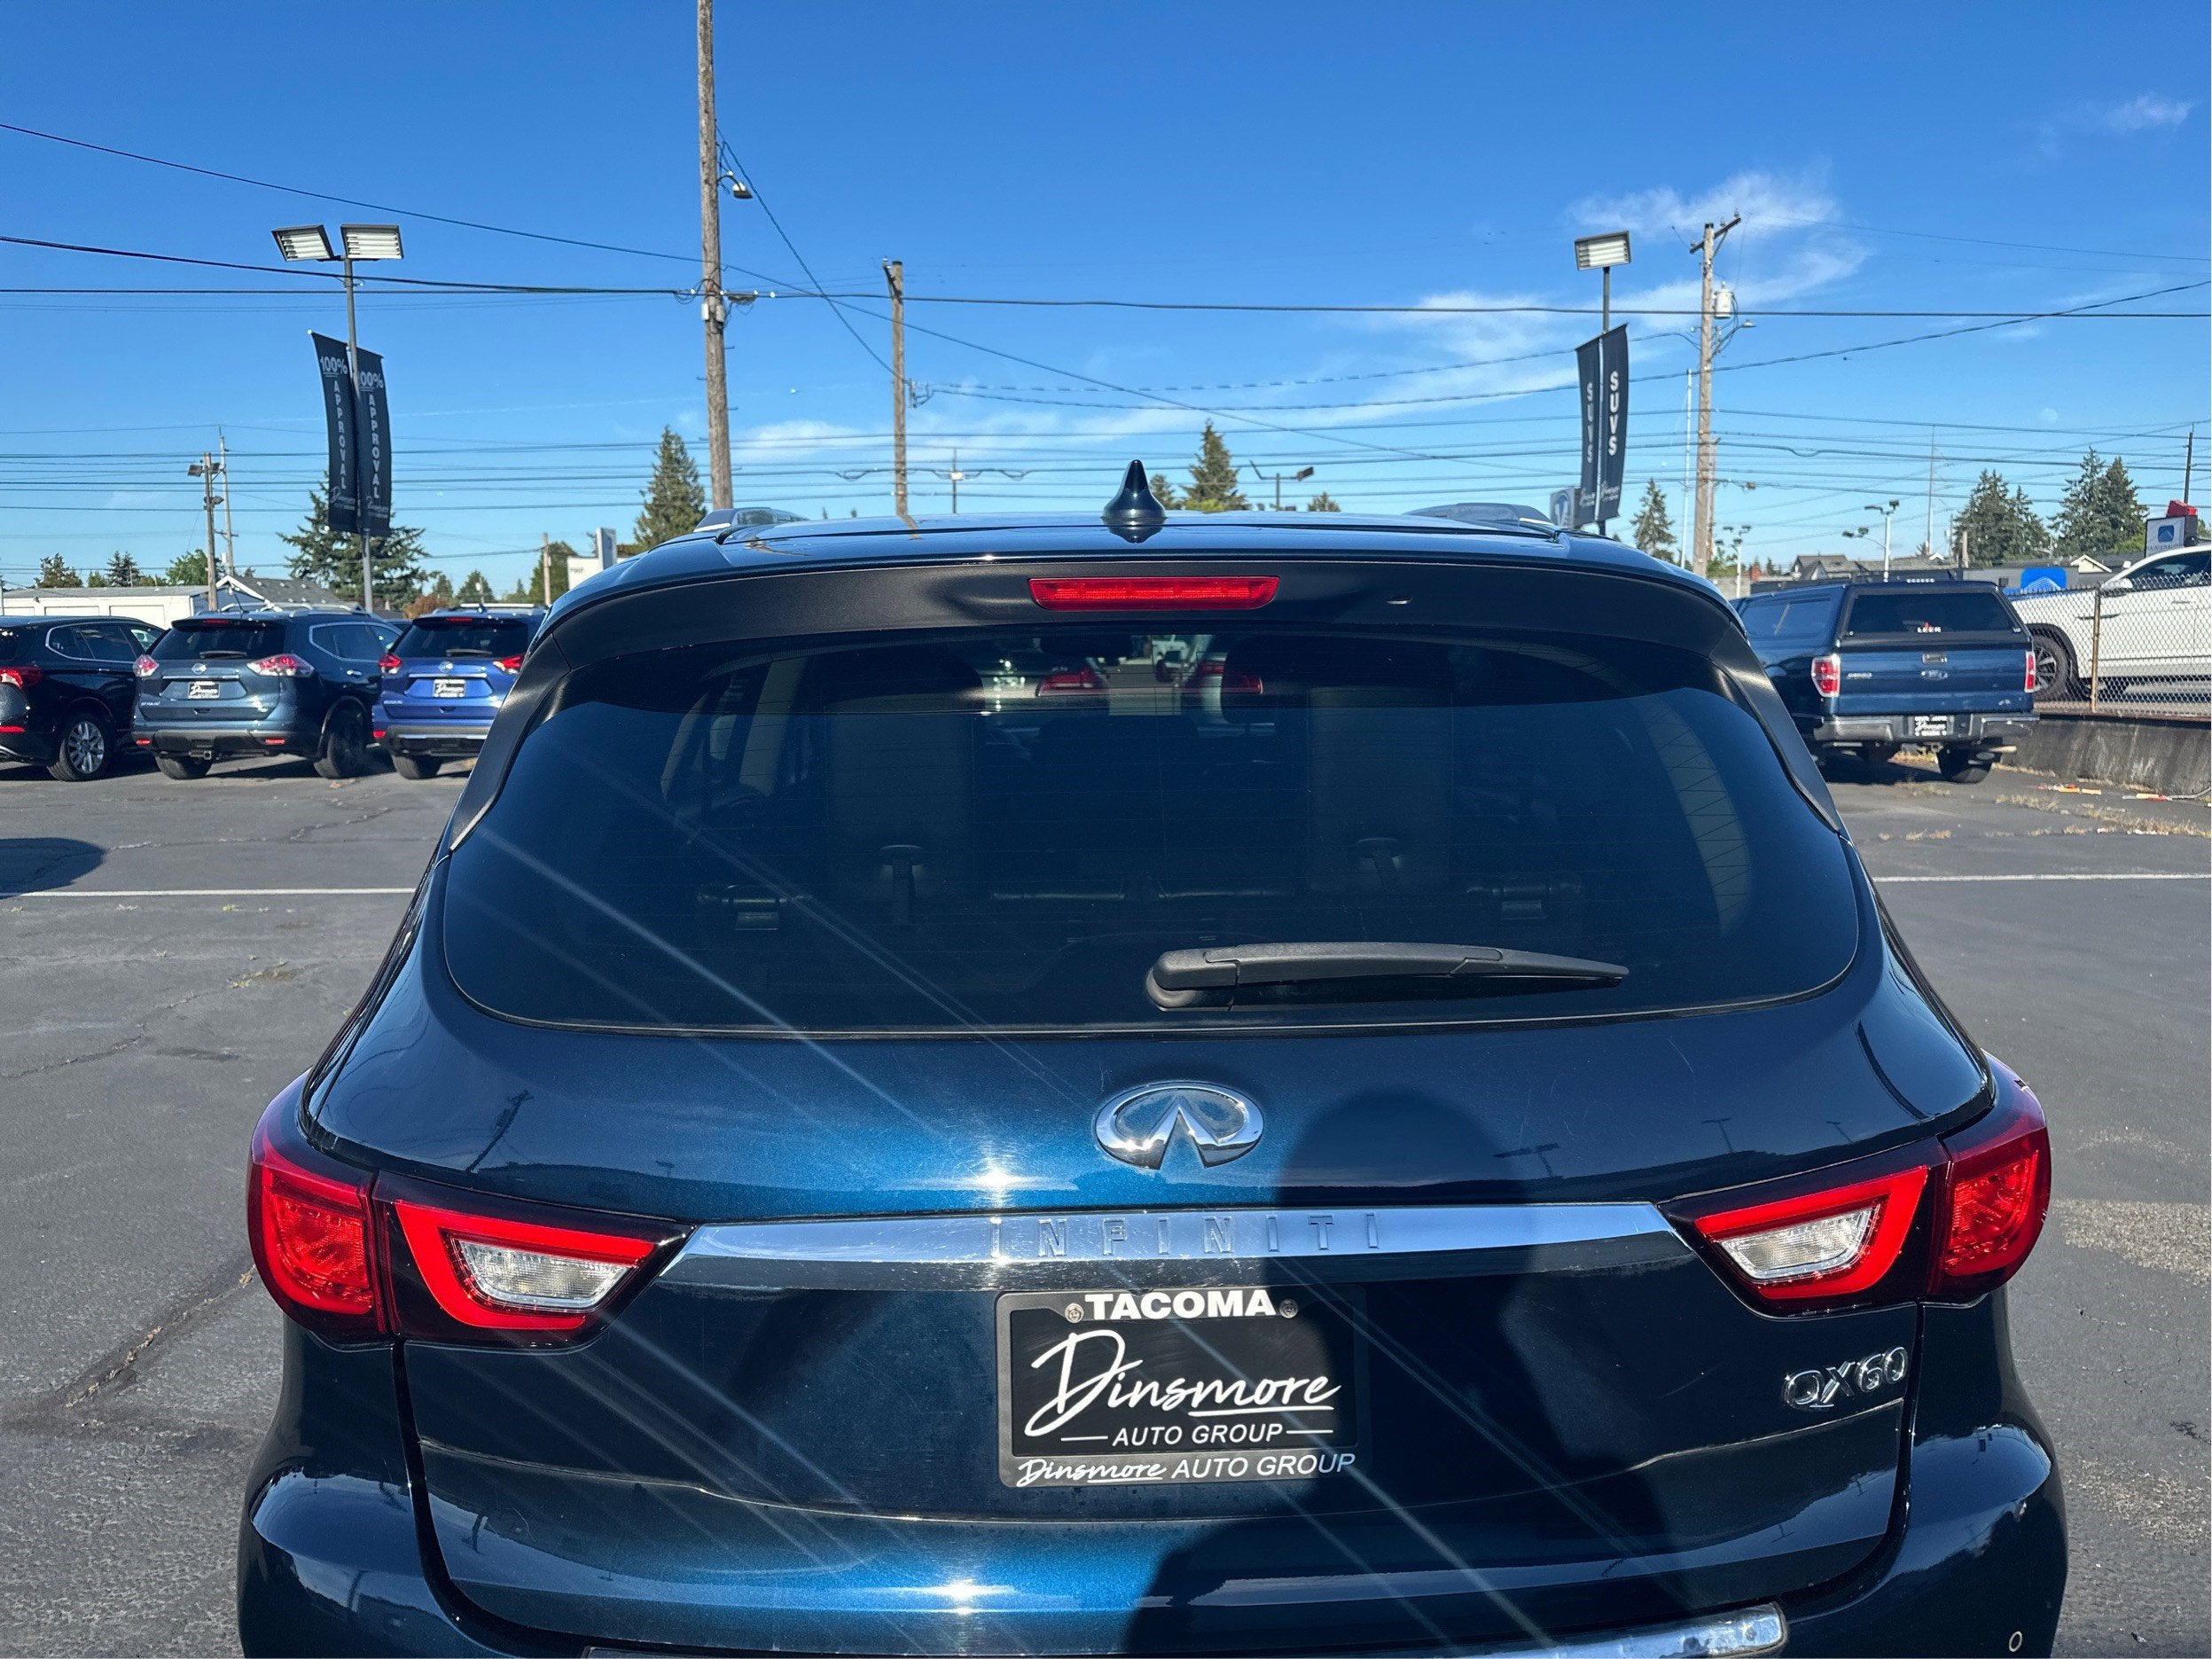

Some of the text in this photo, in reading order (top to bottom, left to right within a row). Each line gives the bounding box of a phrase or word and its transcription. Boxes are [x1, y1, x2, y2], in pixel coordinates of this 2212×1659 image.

[320, 356, 348, 374] 100%
[358, 372, 384, 388] 00%
[333, 380, 347, 489] APPROVAL
[1608, 371, 1619, 456] SUVS
[369, 394, 380, 499] APPROVAL
[990, 1211, 1380, 1258] INFINITI
[1084, 1289, 1277, 1319] TACOMA
[1024, 1329, 1342, 1436] Dinsmore
[1783, 1346, 1908, 1412] QX60
[1112, 1423, 1283, 1446] AUTO GROUP
[1016, 1452, 1356, 1488] Dinsmore AUTO GROUP
